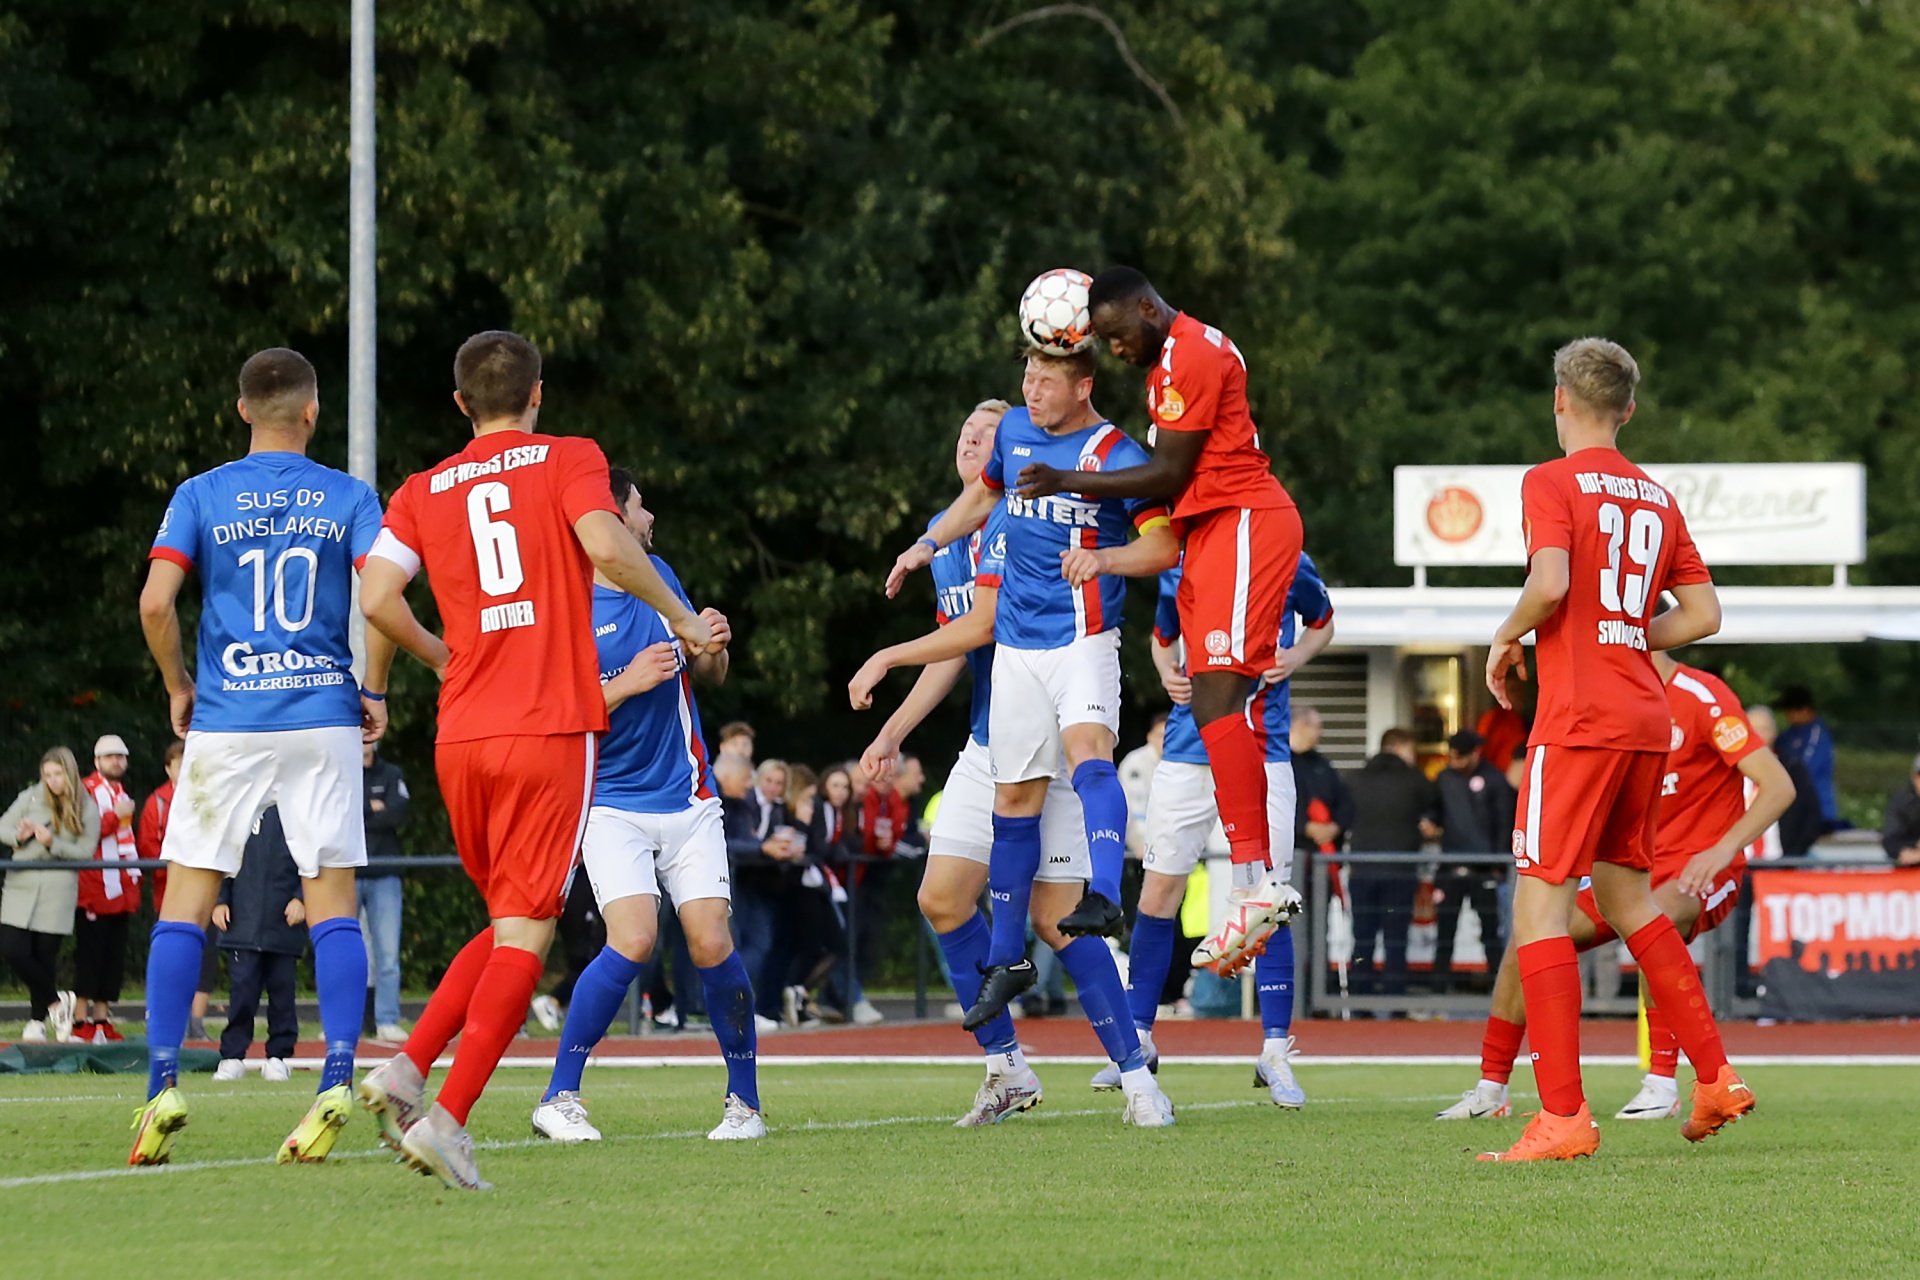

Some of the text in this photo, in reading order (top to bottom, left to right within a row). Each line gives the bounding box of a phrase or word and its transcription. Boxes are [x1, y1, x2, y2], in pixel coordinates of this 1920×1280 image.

[1012, 446, 1031, 457] JAKO
[430, 444, 550, 494] ROT-WEISS ESSEN
[236, 488, 325, 511] SUS 09
[1575, 472, 1669, 509] ROT-WEISS ESSEN
[1005, 493, 1101, 528] WITEK
[212, 516, 347, 545] DINSLAKEN
[466, 481, 524, 597] 6
[1598, 502, 1664, 618] 39
[238, 547, 318, 633] 10
[480, 600, 536, 633] ROTHER
[595, 622, 618, 638] JAKO
[1207, 656, 1232, 666] JAKO
[222, 672, 344, 692] MALERBETRIEB
[1091, 829, 1120, 843] JAKO
[1049, 856, 1071, 864] JAKO
[727, 1050, 754, 1060] JAKO
